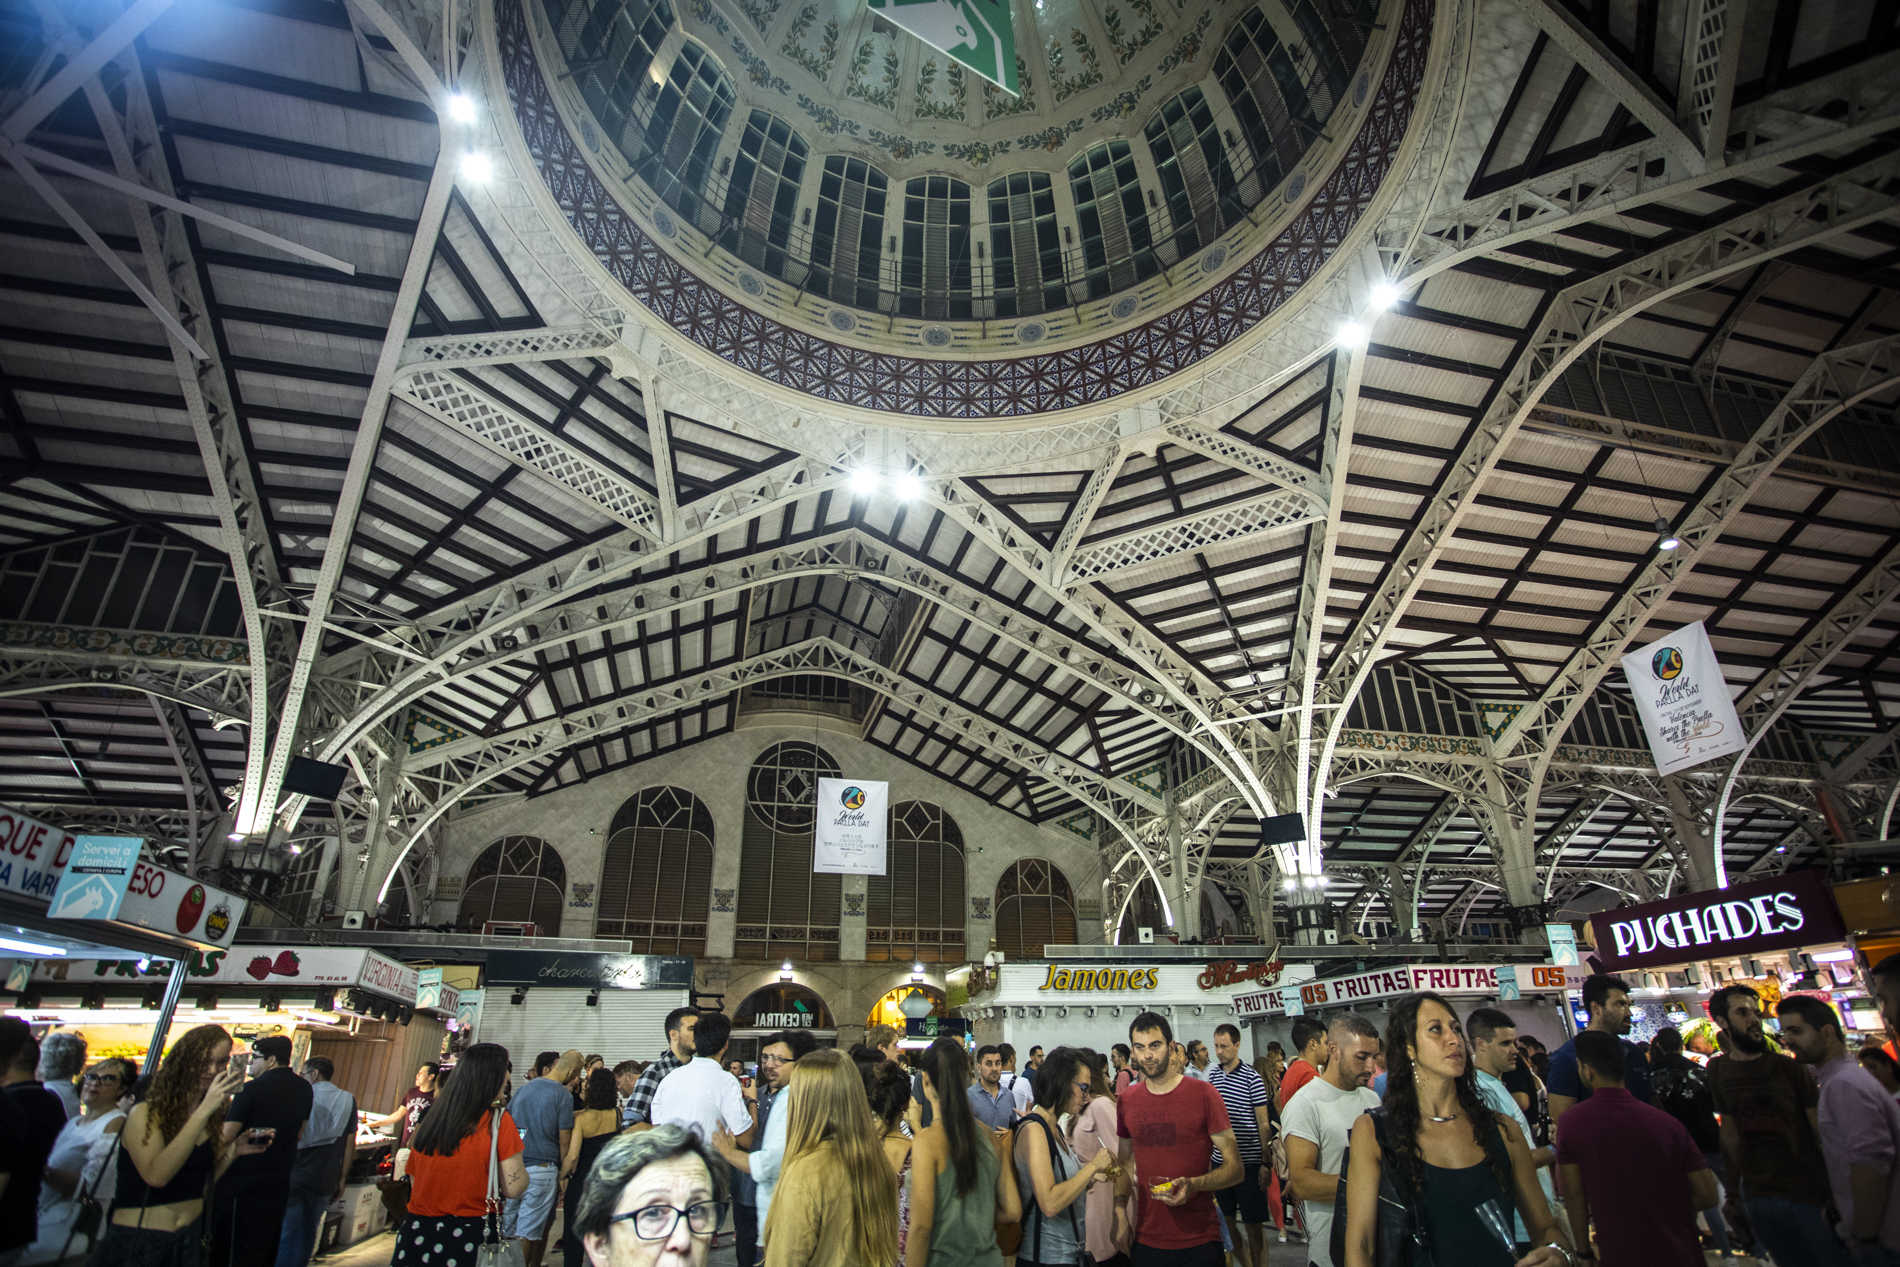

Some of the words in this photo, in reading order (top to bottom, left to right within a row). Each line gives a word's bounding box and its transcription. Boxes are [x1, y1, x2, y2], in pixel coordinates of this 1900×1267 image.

[1659, 677, 1690, 699] World
[1610, 892, 1804, 957] PUCHADES
[1040, 964, 1160, 991] Jamones
[1335, 970, 1411, 1000] FRUTAS
[1412, 967, 1499, 989] FRUTAS
[1532, 966, 1566, 988] OS
